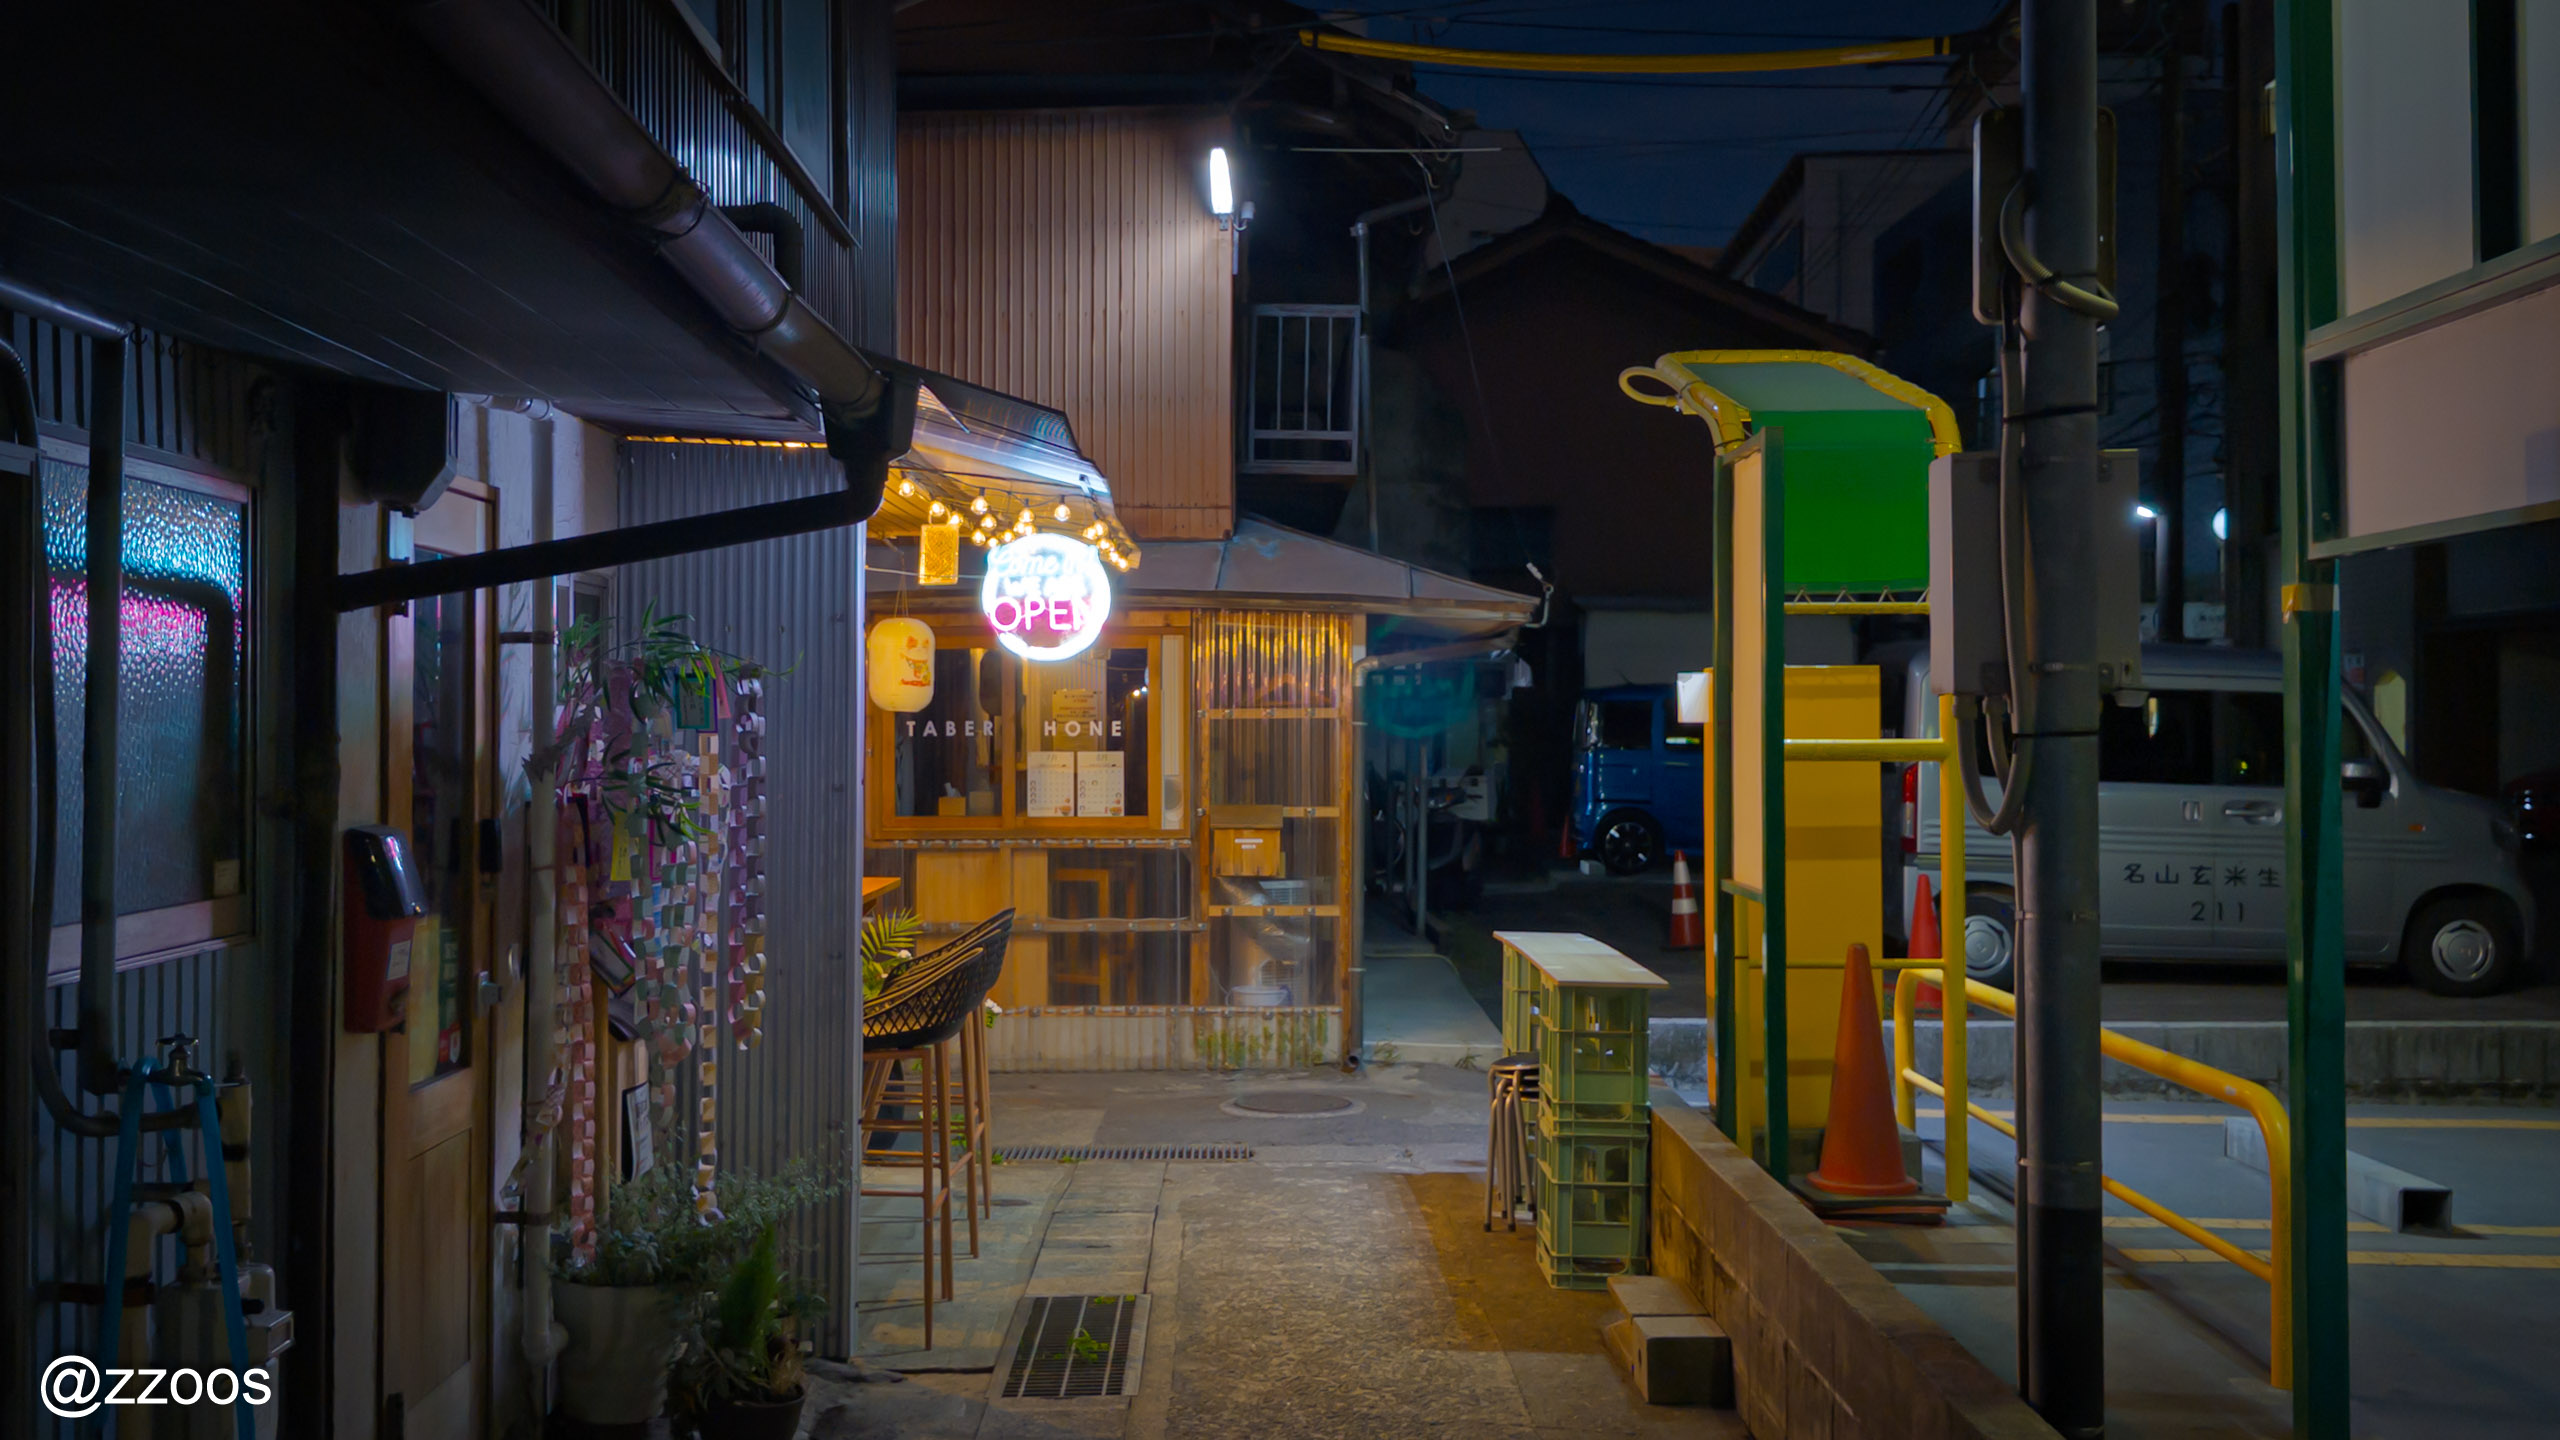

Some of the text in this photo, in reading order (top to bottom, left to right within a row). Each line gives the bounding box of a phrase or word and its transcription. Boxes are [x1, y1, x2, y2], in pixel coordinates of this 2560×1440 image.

[990, 596, 1099, 632] OPEN
[906, 720, 1122, 737] TABER HONE
[2123, 862, 2282, 889] 名山玄米生
[2191, 901, 2244, 922] 211
